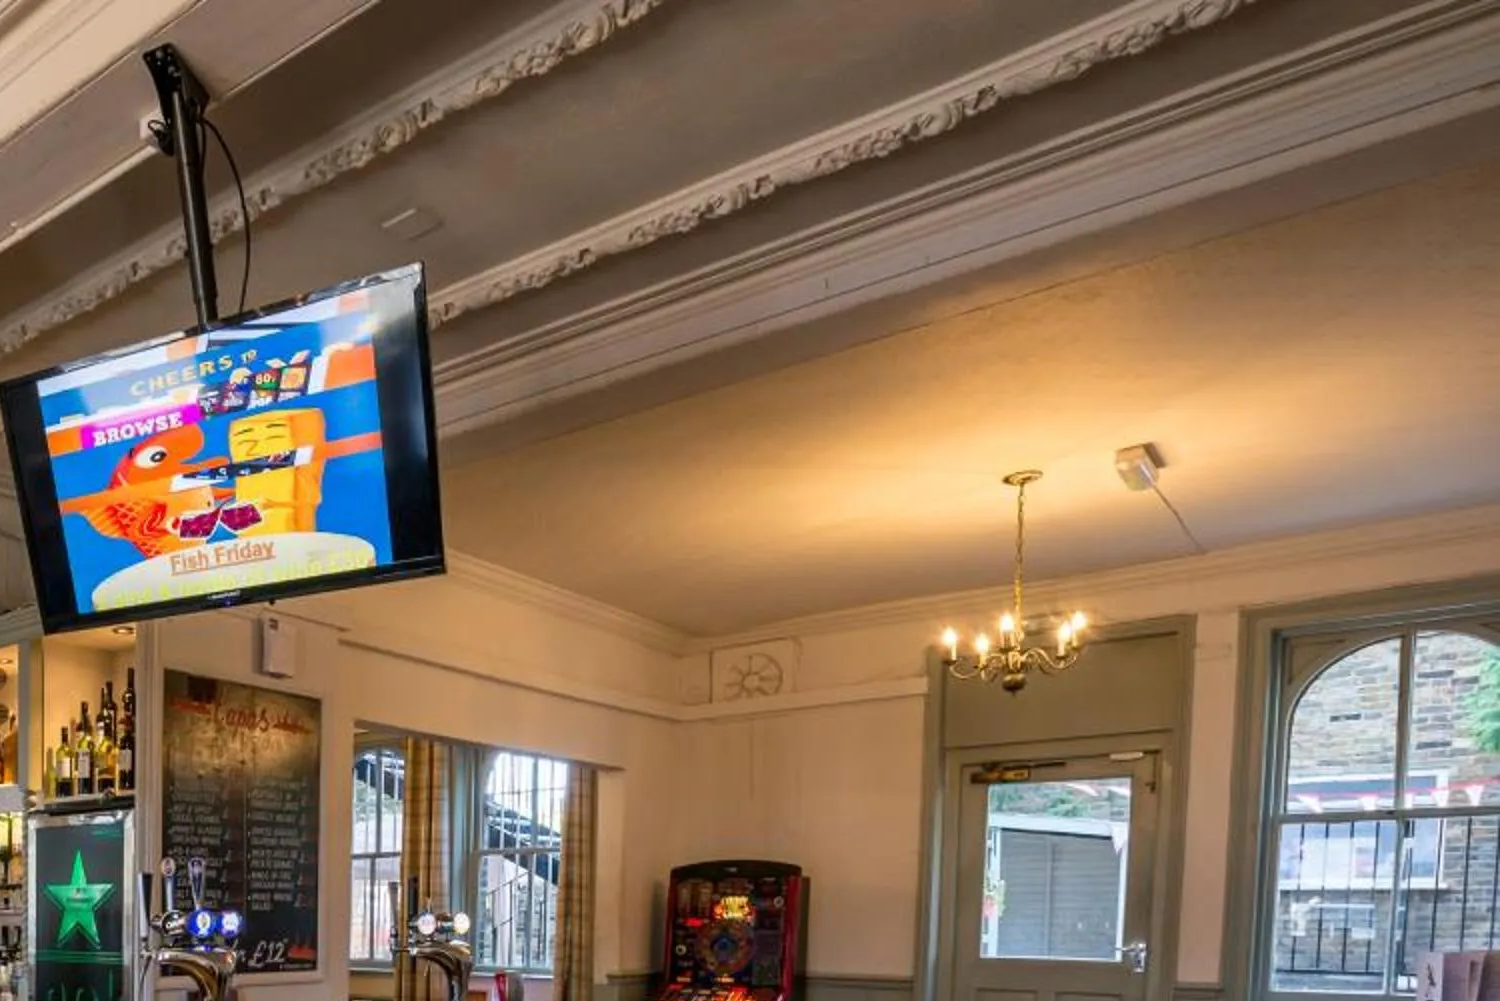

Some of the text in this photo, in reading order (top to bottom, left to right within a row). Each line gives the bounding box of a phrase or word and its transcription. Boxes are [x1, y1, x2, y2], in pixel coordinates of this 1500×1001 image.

[130, 354, 233, 397] CHEERS
[92, 411, 184, 448] BROWSE
[170, 551, 209, 573] Fish
[215, 541, 276, 565] Friday
